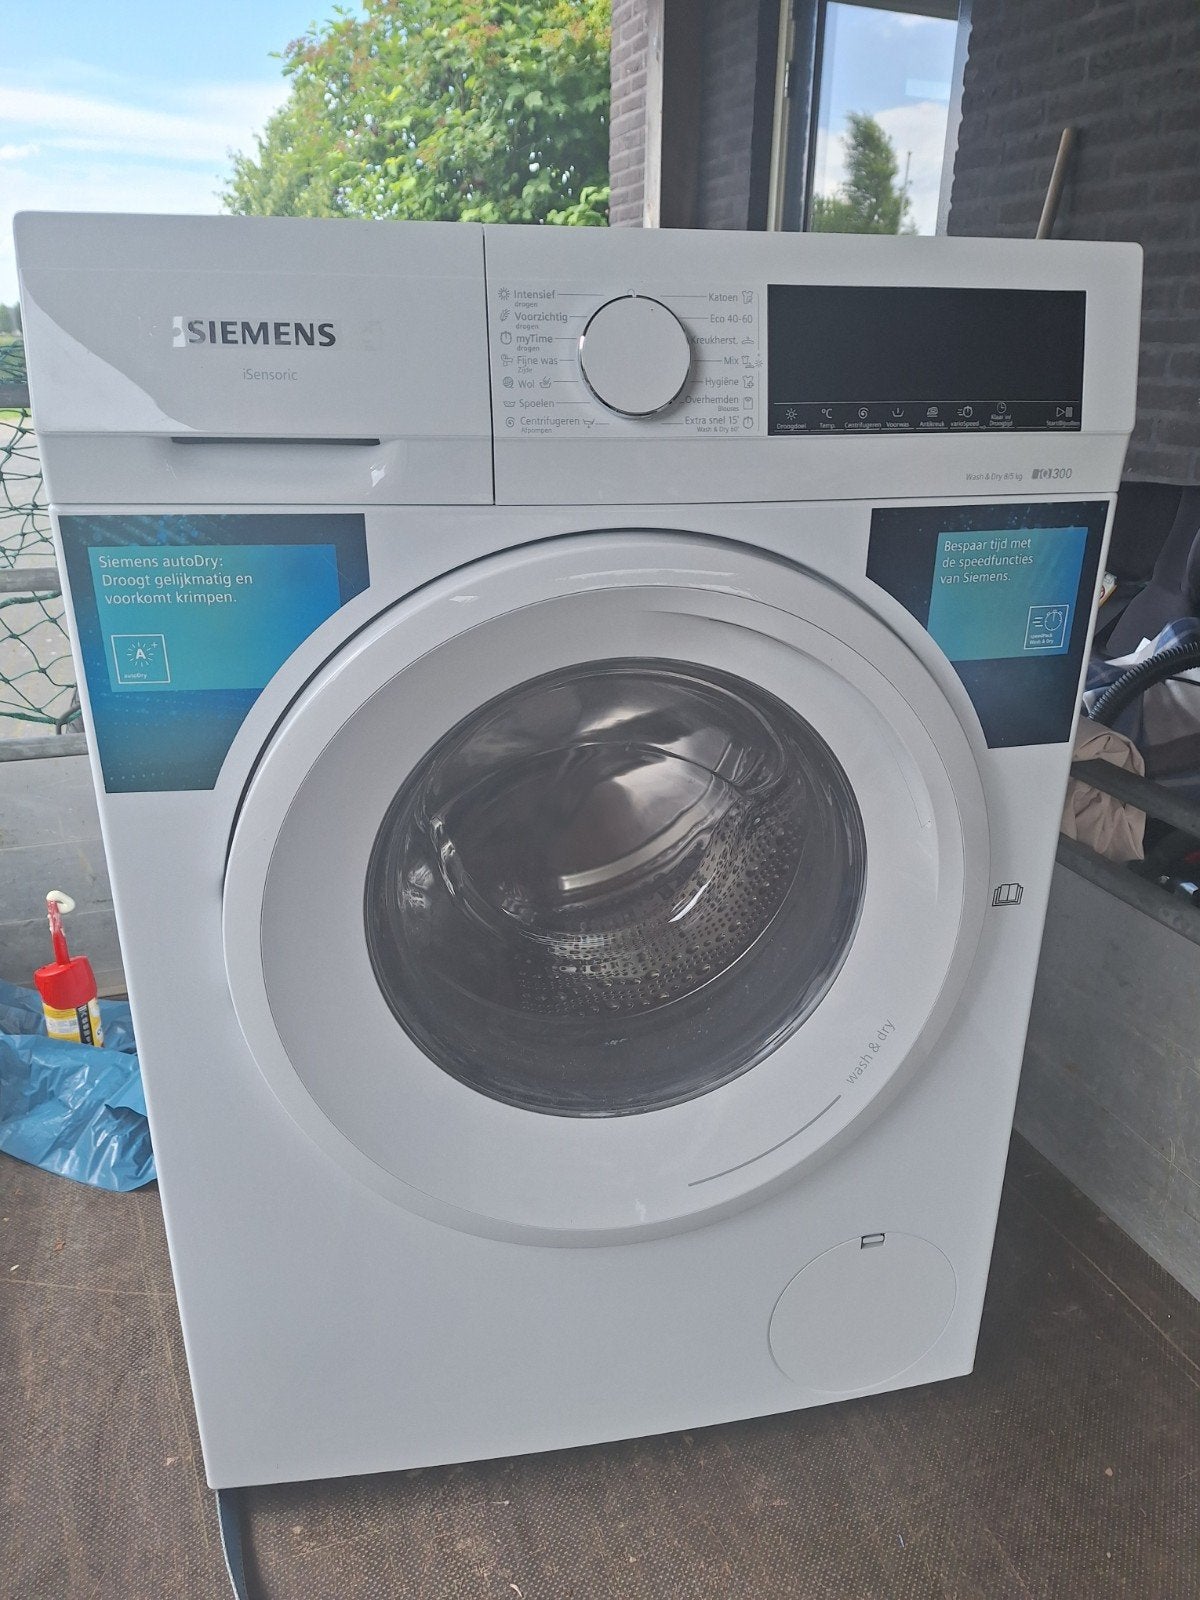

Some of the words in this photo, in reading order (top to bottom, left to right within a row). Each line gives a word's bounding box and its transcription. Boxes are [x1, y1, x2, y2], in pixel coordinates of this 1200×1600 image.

[513, 289, 556, 299] Intensief
[708, 292, 738, 302] Katoen
[514, 301, 538, 309] drogen
[514, 311, 568, 324] Voorzichtig
[710, 313, 725, 323] Eco
[727, 314, 753, 324] 40-60
[187, 319, 337, 347] SIEMENS
[515, 323, 539, 331] drogen
[516, 333, 553, 345] myTime
[516, 345, 540, 353] drogen
[516, 355, 539, 367] Fijne
[540, 357, 559, 365] was
[723, 356, 739, 365] Mix
[242, 368, 299, 381] iSensoric
[517, 379, 535, 389] Wol
[518, 398, 555, 410] Spoelen
[685, 394, 739, 404] Overhemden
[520, 415, 580, 428] Centrifugeren
[684, 415, 707, 425] Extra
[708, 415, 726, 425] snel
[844, 421, 882, 430] Centrifugeren
[965, 472, 984, 481] Wash
[984, 472, 990, 481] &
[990, 472, 1003, 482] Dry
[1015, 471, 1023, 482] kg
[944, 540, 988, 554] Bespaar
[990, 537, 1008, 553] tijd
[1010, 538, 1032, 549] met
[98, 554, 159, 569] Siemens
[162, 554, 224, 571] autoDry:
[942, 556, 956, 568] de
[959, 554, 1034, 570] speedfuncties
[101, 573, 151, 589] Droogt
[154, 572, 232, 589] gelijkmatig
[235, 574, 253, 586] en
[939, 574, 960, 584] van
[962, 571, 1011, 584] Siemens.
[104, 591, 172, 605] voorkomt
[175, 590, 237, 606] krimpen.
[846, 1054, 873, 1084] wash
[868, 1042, 881, 1053] &
[877, 1018, 896, 1041] dry
